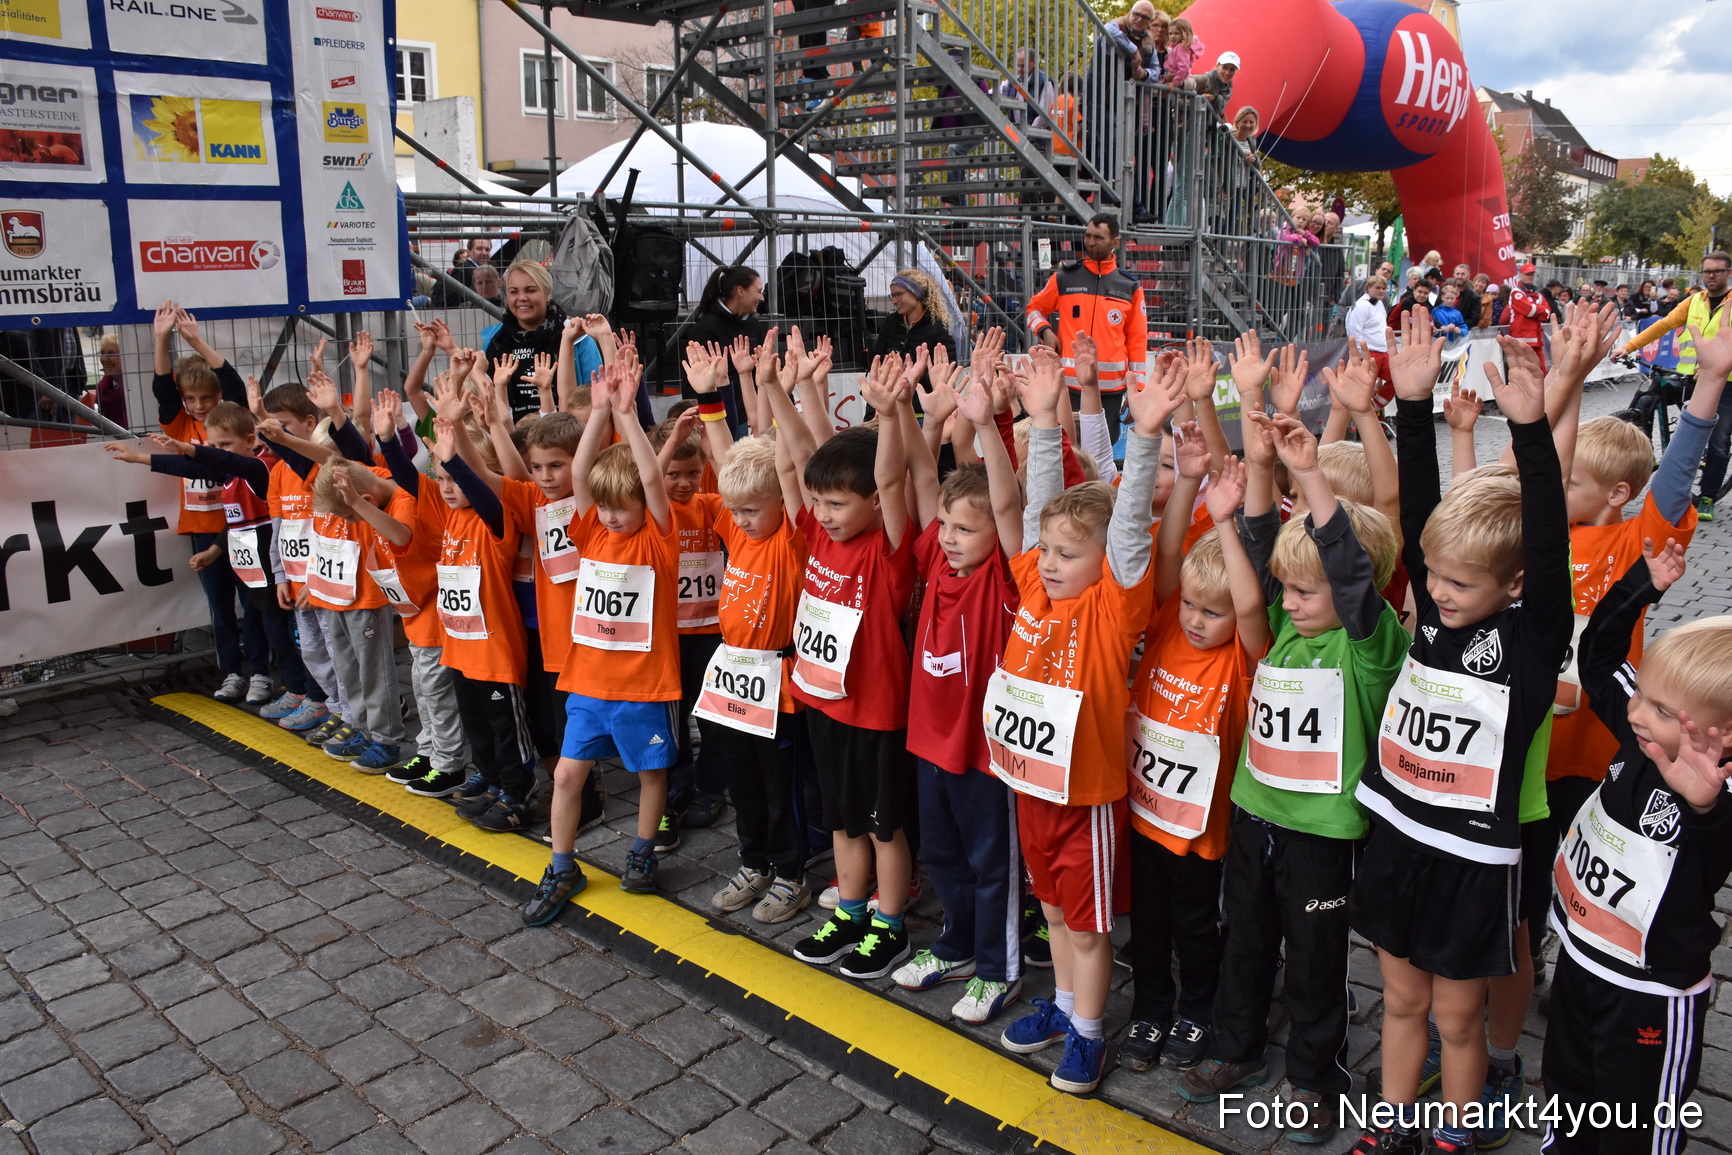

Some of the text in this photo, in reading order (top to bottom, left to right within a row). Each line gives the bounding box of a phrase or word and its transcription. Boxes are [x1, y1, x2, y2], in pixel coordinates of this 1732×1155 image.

[321, 38, 366, 51] PFLEIDERER
[327, 113, 365, 129] Burgis
[209, 143, 261, 158] KANN
[323, 155, 356, 167] swn
[340, 221, 376, 229] VARIOTEC
[147, 240, 245, 263] charivari
[601, 571, 627, 581] BOCK
[440, 588, 471, 612] 265
[585, 586, 639, 616] 7067
[808, 606, 831, 620] BOCK
[598, 624, 616, 635] Theo
[798, 621, 838, 664] 7246
[1065, 618, 1078, 690] BAMBINI
[727, 653, 755, 665] BOCK
[713, 666, 766, 703] 7030
[1012, 686, 1045, 705] BOCK
[1263, 676, 1304, 692] BOCK
[1417, 677, 1464, 700] BOCK
[727, 703, 747, 716] Elias
[1251, 695, 1322, 744] 7314
[994, 704, 1056, 757] 7202
[1397, 697, 1482, 756] 7057
[1148, 729, 1185, 750] BOCK
[999, 743, 1026, 780] TIM
[1132, 737, 1198, 795] 7277
[1398, 754, 1456, 784] Benjamin
[1135, 785, 1158, 811] MAXI
[1592, 818, 1626, 854] BOCK
[1569, 823, 1636, 910] 7087
[1319, 896, 1347, 910] asics
[1570, 891, 1587, 918] Leo
[1637, 1037, 1663, 1045] adidas
